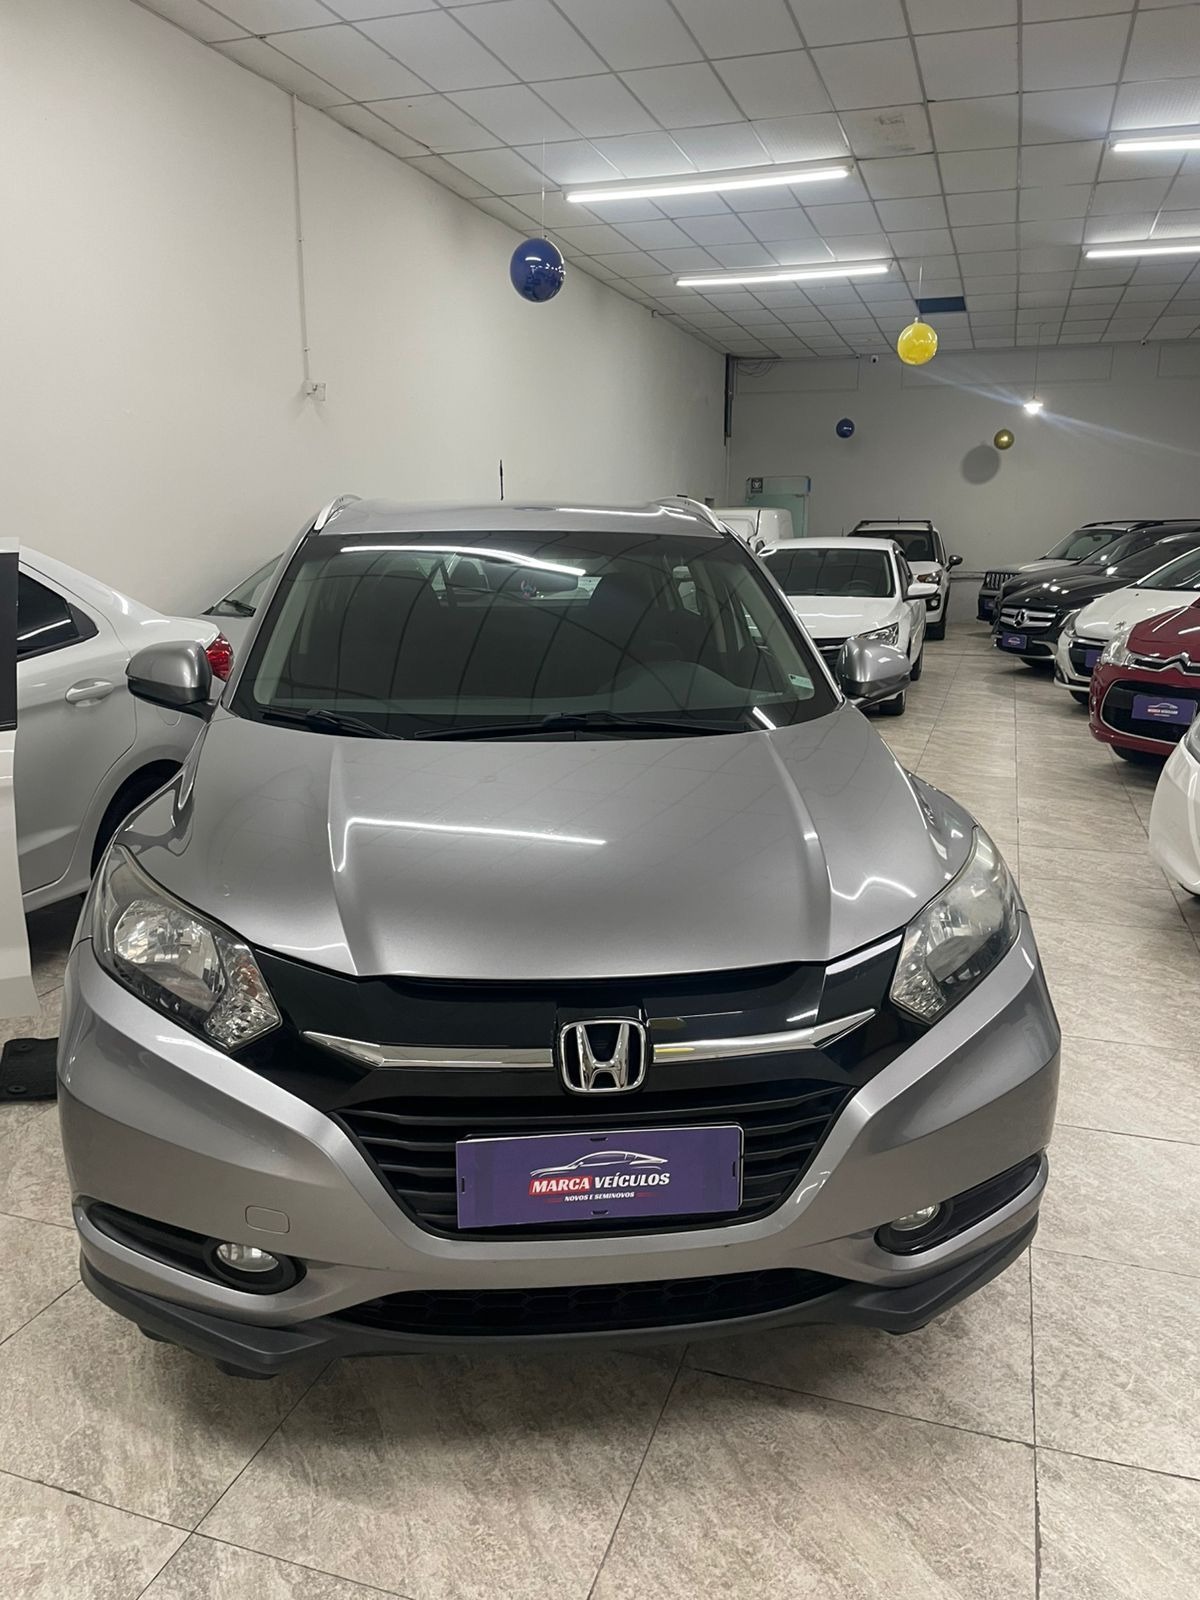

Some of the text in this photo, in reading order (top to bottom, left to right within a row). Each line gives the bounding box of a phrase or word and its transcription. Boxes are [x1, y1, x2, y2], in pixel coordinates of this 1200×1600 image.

[531, 1172, 671, 1193] MARCA VEÍCULOS
[564, 1194, 588, 1202] NOVOS
[594, 1191, 635, 1200] SEMINOVOS
